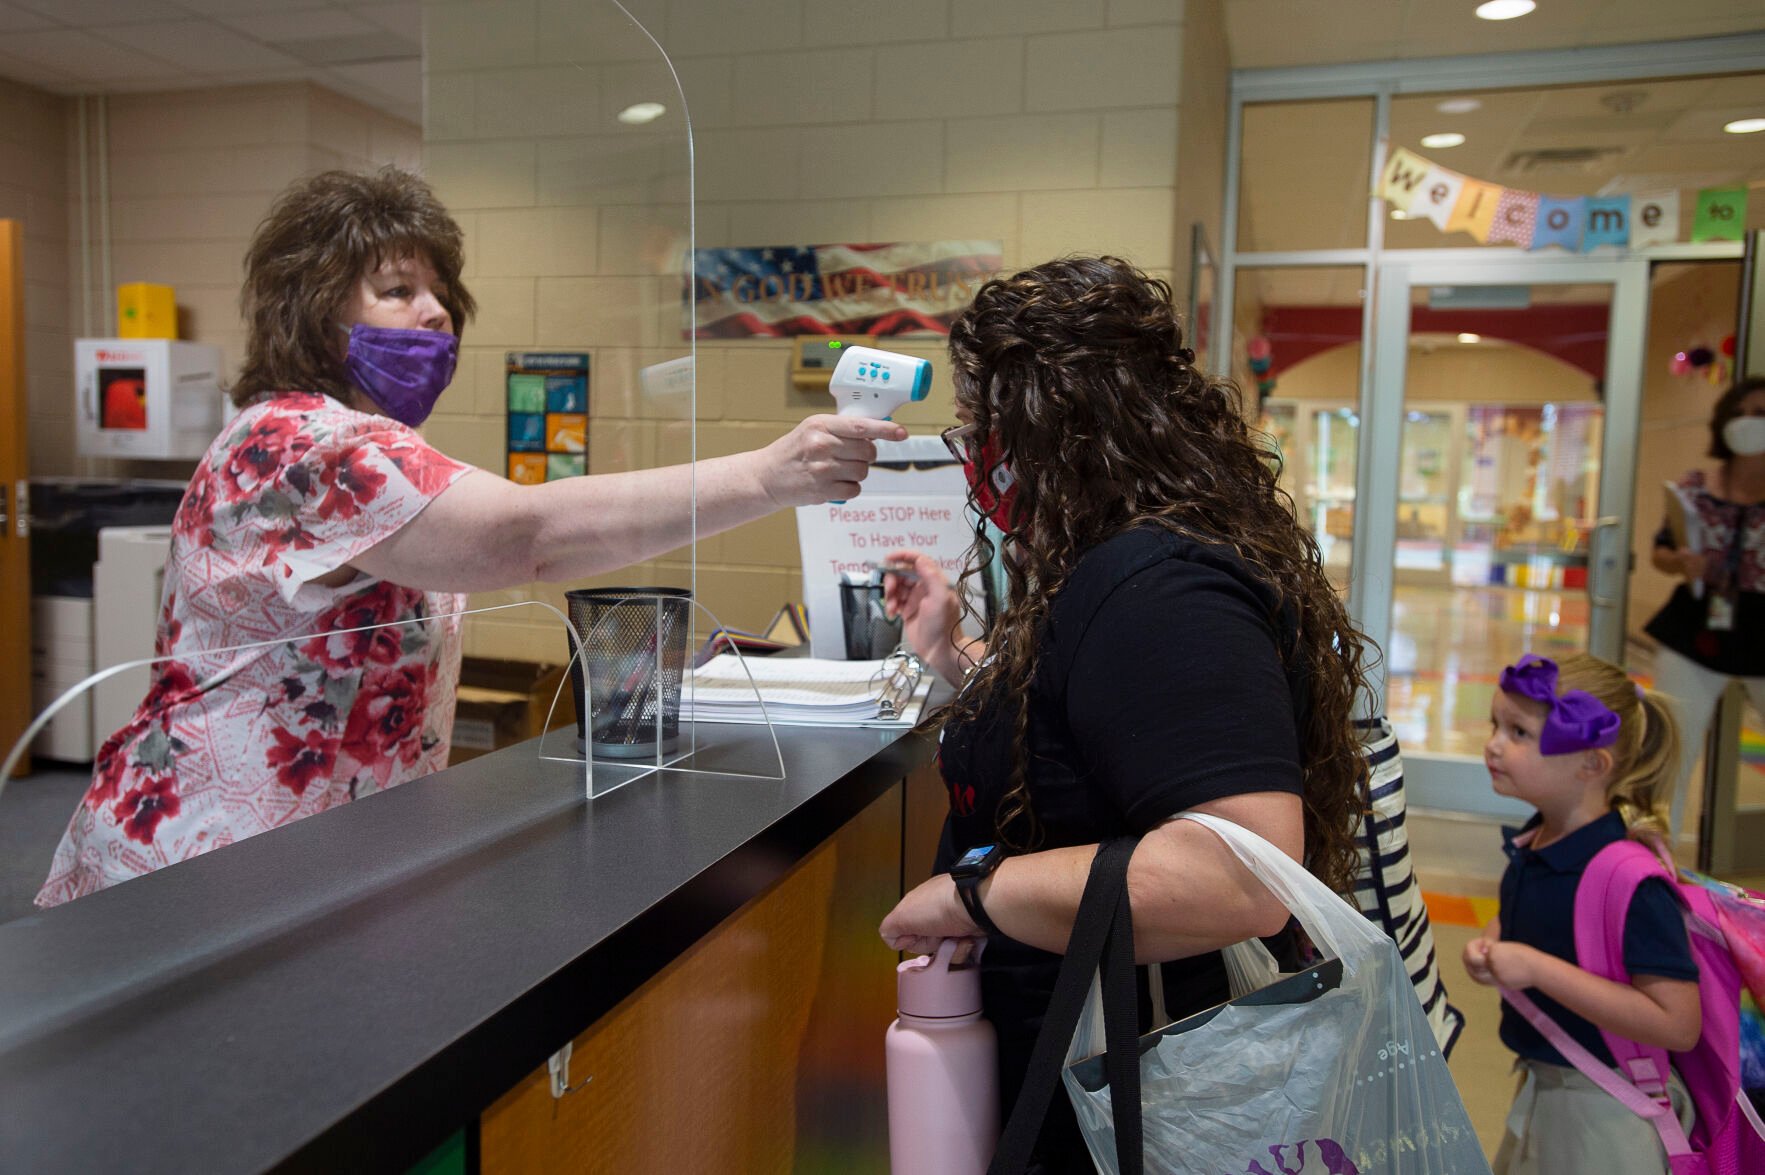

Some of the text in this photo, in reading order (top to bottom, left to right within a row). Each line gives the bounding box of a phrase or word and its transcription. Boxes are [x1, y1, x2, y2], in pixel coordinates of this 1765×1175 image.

[1389, 155, 1735, 233] Welcome to
[731, 273, 813, 304] GOD
[821, 273, 870, 303] WE
[829, 506, 951, 522] Please STOP Here
[849, 533, 938, 547] To Have Your
[1377, 1040, 1409, 1061] Age
